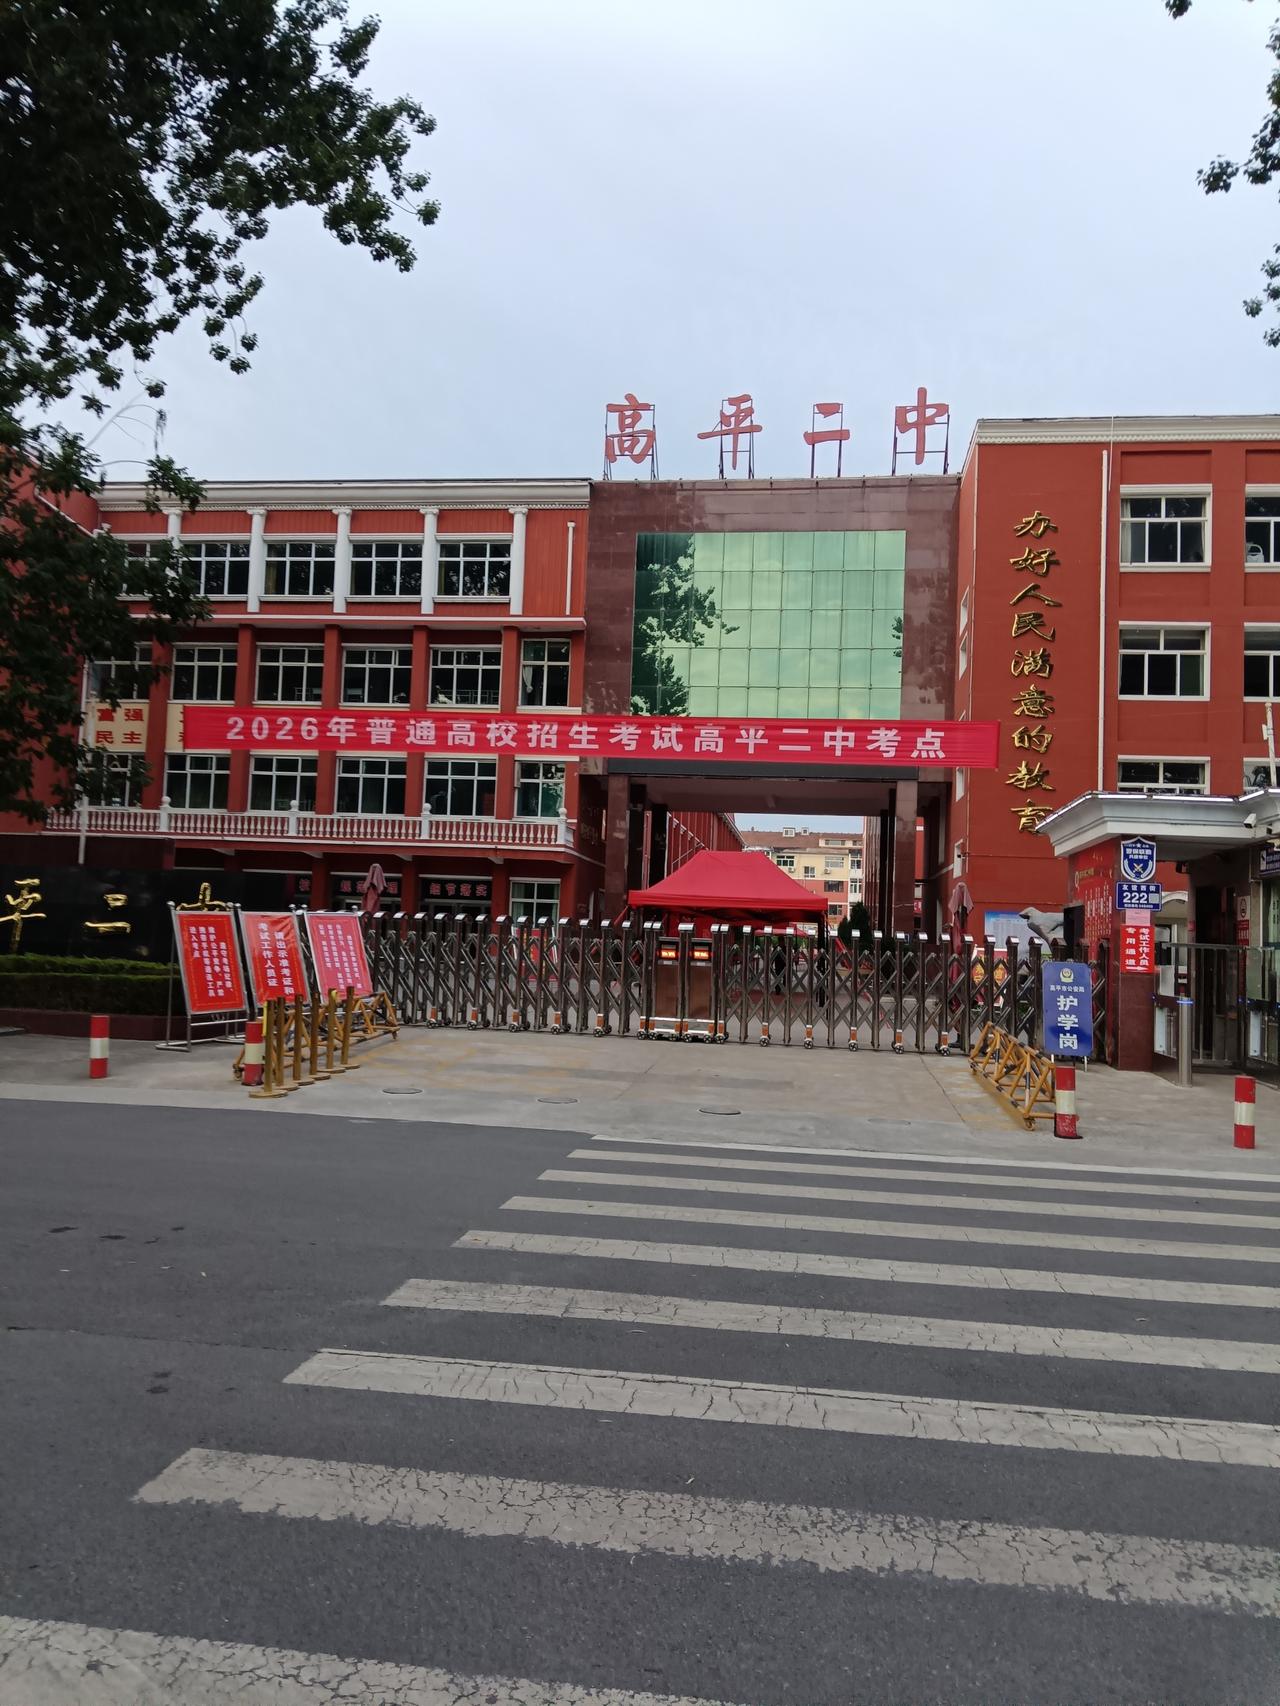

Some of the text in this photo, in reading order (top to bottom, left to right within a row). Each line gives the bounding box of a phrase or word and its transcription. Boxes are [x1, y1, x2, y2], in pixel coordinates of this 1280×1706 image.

[605, 388, 949, 470] 高平二中
[1006, 510, 1062, 834] 办好人民满意的教育
[96, 707, 144, 722] 富强
[95, 730, 142, 745] 民主
[227, 715, 946, 760] 2026年普通高校招生考试高平二中考点
[1123, 892, 1148, 904] 222
[1125, 927, 1136, 966] 专用通道
[1138, 927, 1150, 966] 考试工作人员
[1056, 995, 1079, 1050] 护学岗
